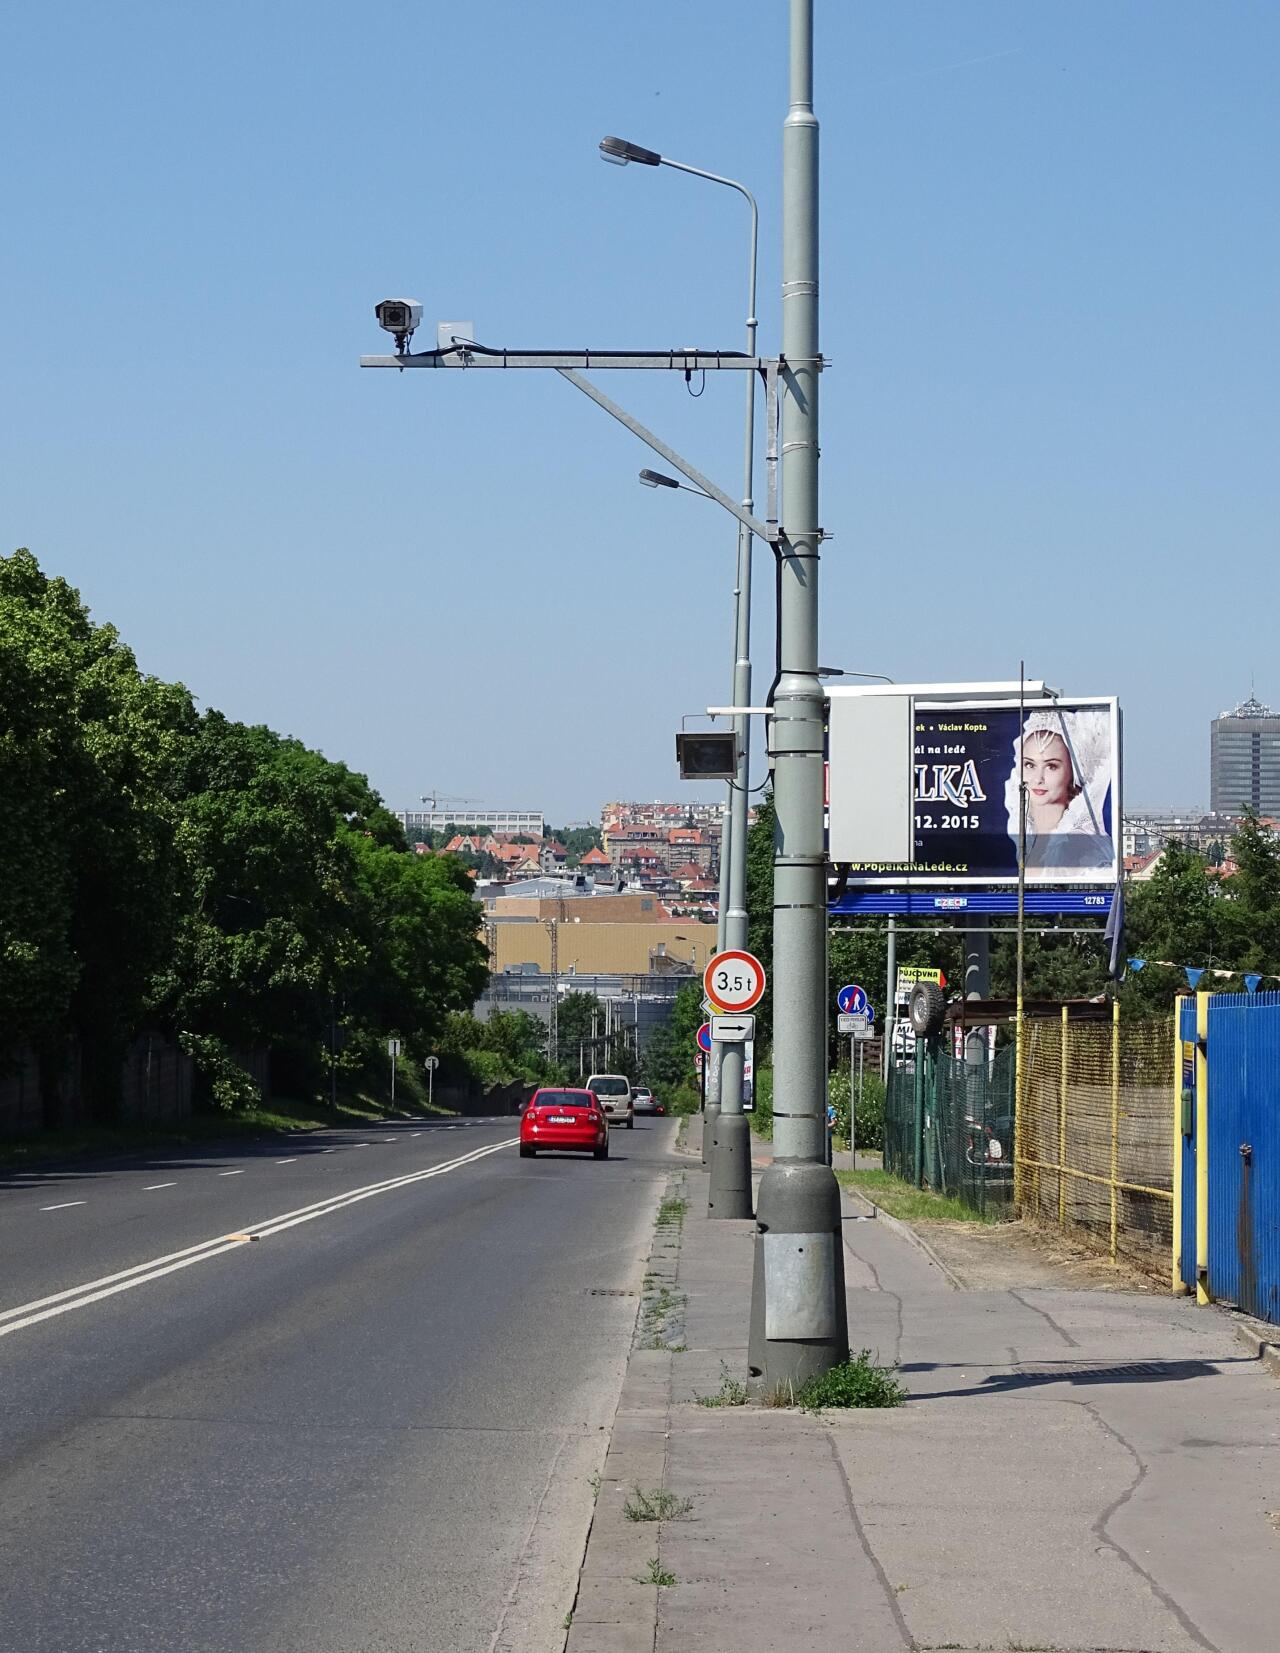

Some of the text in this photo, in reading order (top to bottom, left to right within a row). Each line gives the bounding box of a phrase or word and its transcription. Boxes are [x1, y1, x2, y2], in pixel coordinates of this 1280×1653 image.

[915, 723, 987, 733] ek Václav Kopta
[914, 745, 966, 754] ál na ledě
[914, 759, 987, 808] LKA
[914, 815, 979, 829] 12. 2015
[717, 971, 752, 992] 3,5 t
